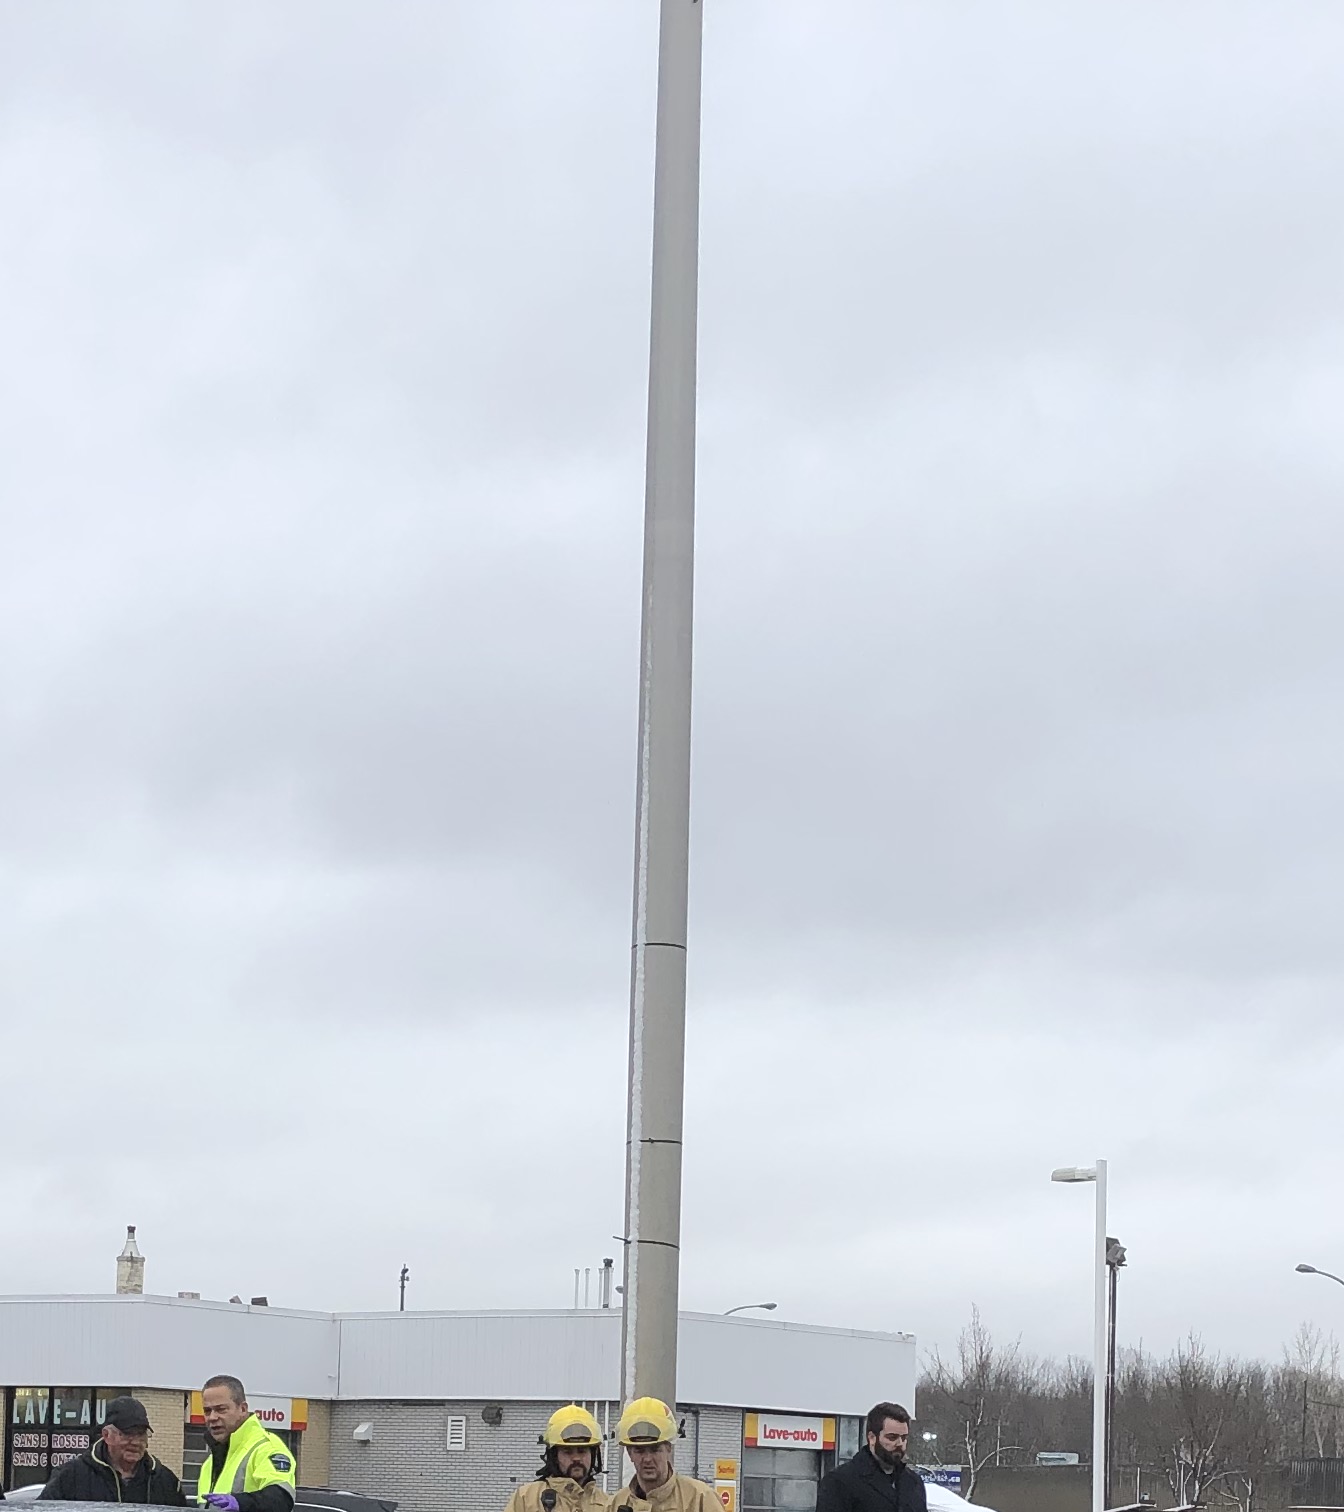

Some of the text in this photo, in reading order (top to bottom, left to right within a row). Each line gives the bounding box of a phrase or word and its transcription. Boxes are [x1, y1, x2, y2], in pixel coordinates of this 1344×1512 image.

[13, 1399, 107, 1425] LAVE-AU
[13, 1433, 38, 1448] SANS
[763, 1424, 818, 1442] Lave-auto
[13, 1452, 38, 1467] SANS
